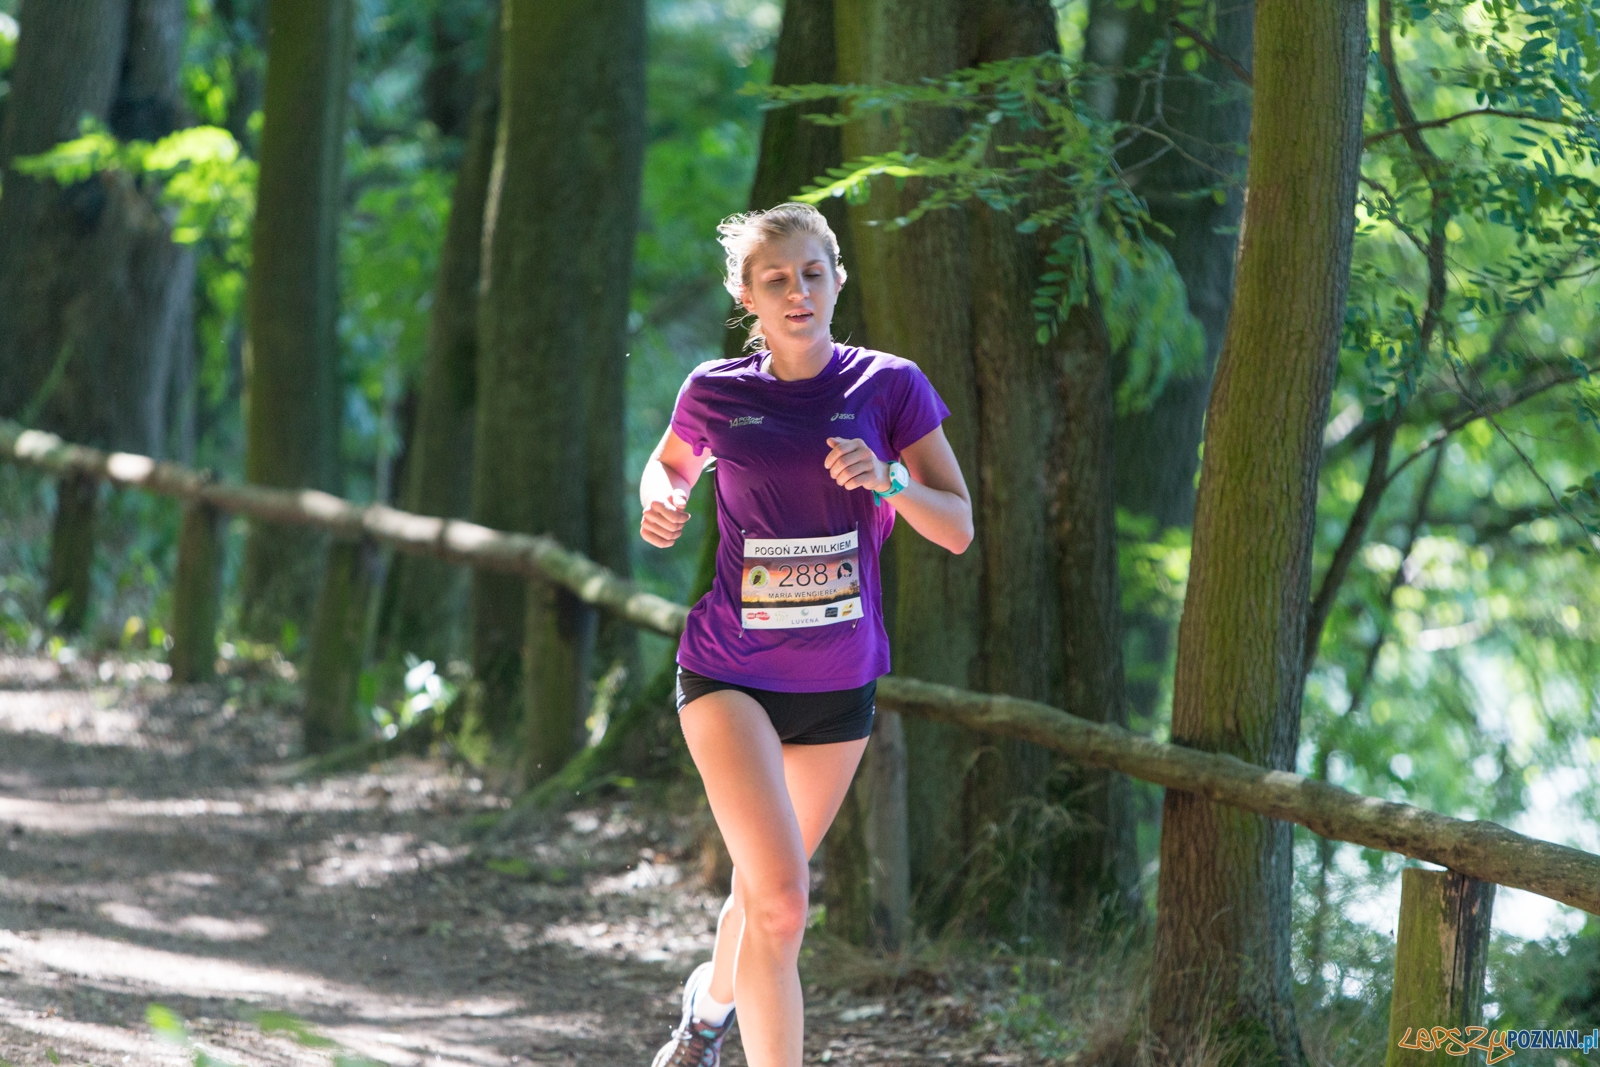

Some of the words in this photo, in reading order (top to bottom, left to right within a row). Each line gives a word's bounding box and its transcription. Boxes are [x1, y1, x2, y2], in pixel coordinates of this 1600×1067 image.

[729, 417, 738, 429] 14
[755, 544, 790, 556] POGOŃ
[793, 545, 808, 555] ZA
[810, 540, 851, 554] WILKIEM
[778, 563, 828, 588] 288
[794, 588, 837, 598] WENGIEREK
[791, 617, 819, 625] LUVENA
